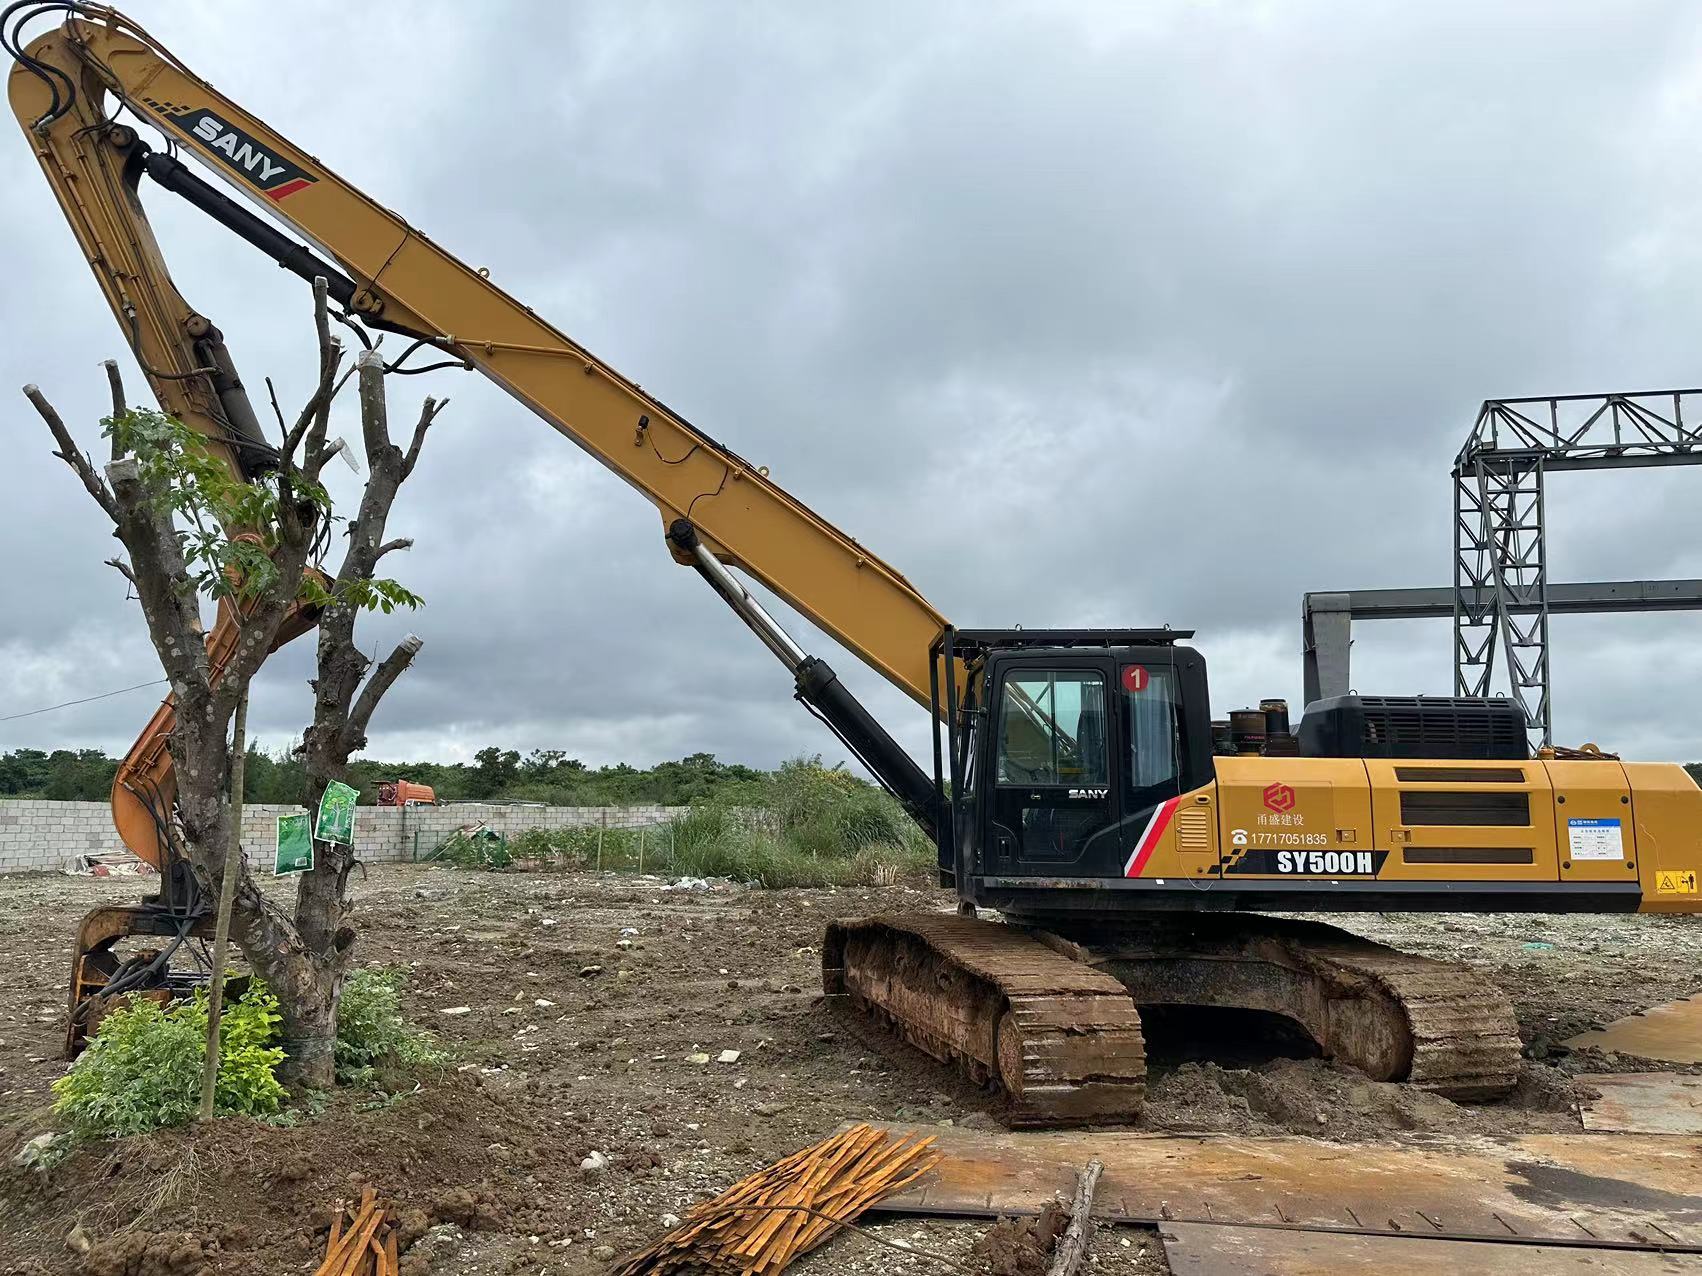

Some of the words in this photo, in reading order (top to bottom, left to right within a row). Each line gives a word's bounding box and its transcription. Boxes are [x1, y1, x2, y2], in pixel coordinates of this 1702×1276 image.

[192, 116, 286, 181] SANY
[1130, 668, 1141, 689] 1
[1068, 789, 1109, 799] SANY
[1251, 833, 1327, 845] 17717051835
[1277, 851, 1372, 873] SY500H
